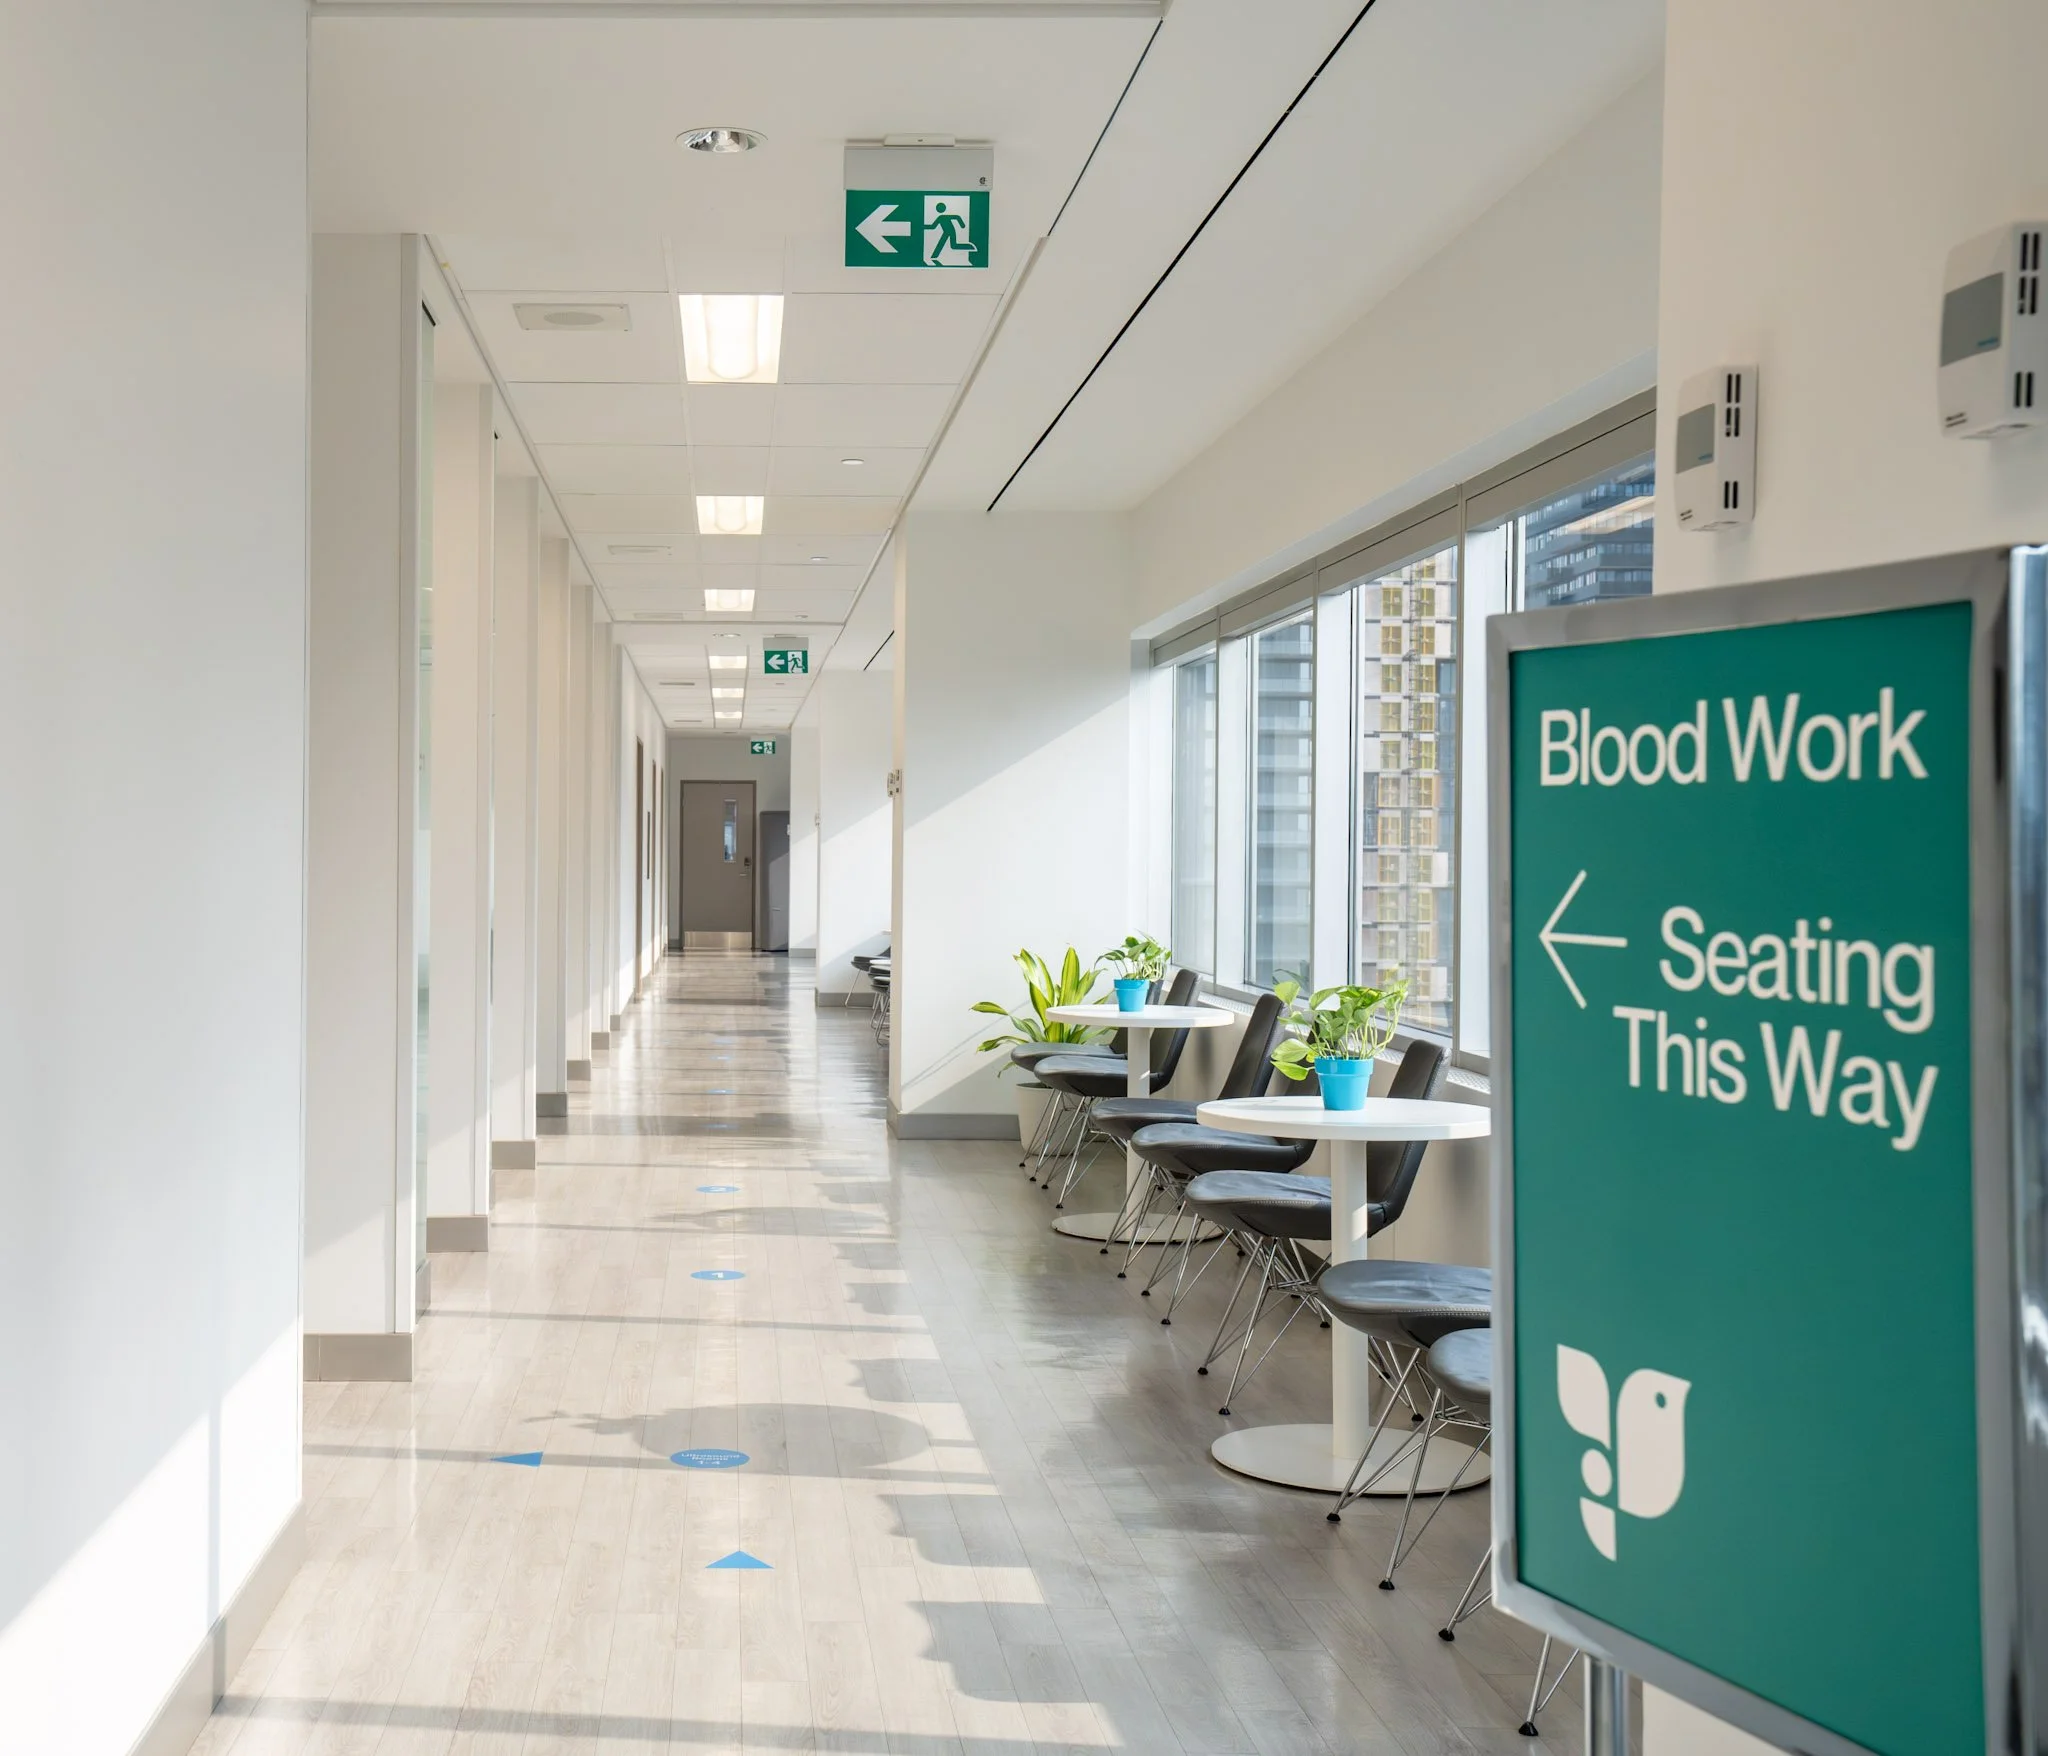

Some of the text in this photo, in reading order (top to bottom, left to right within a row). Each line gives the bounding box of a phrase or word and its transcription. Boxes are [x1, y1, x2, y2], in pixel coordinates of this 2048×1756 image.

[1540, 687, 1929, 786] Blood Work
[1659, 905, 1935, 1033] Seating
[1613, 1005, 1939, 1151] This Way
